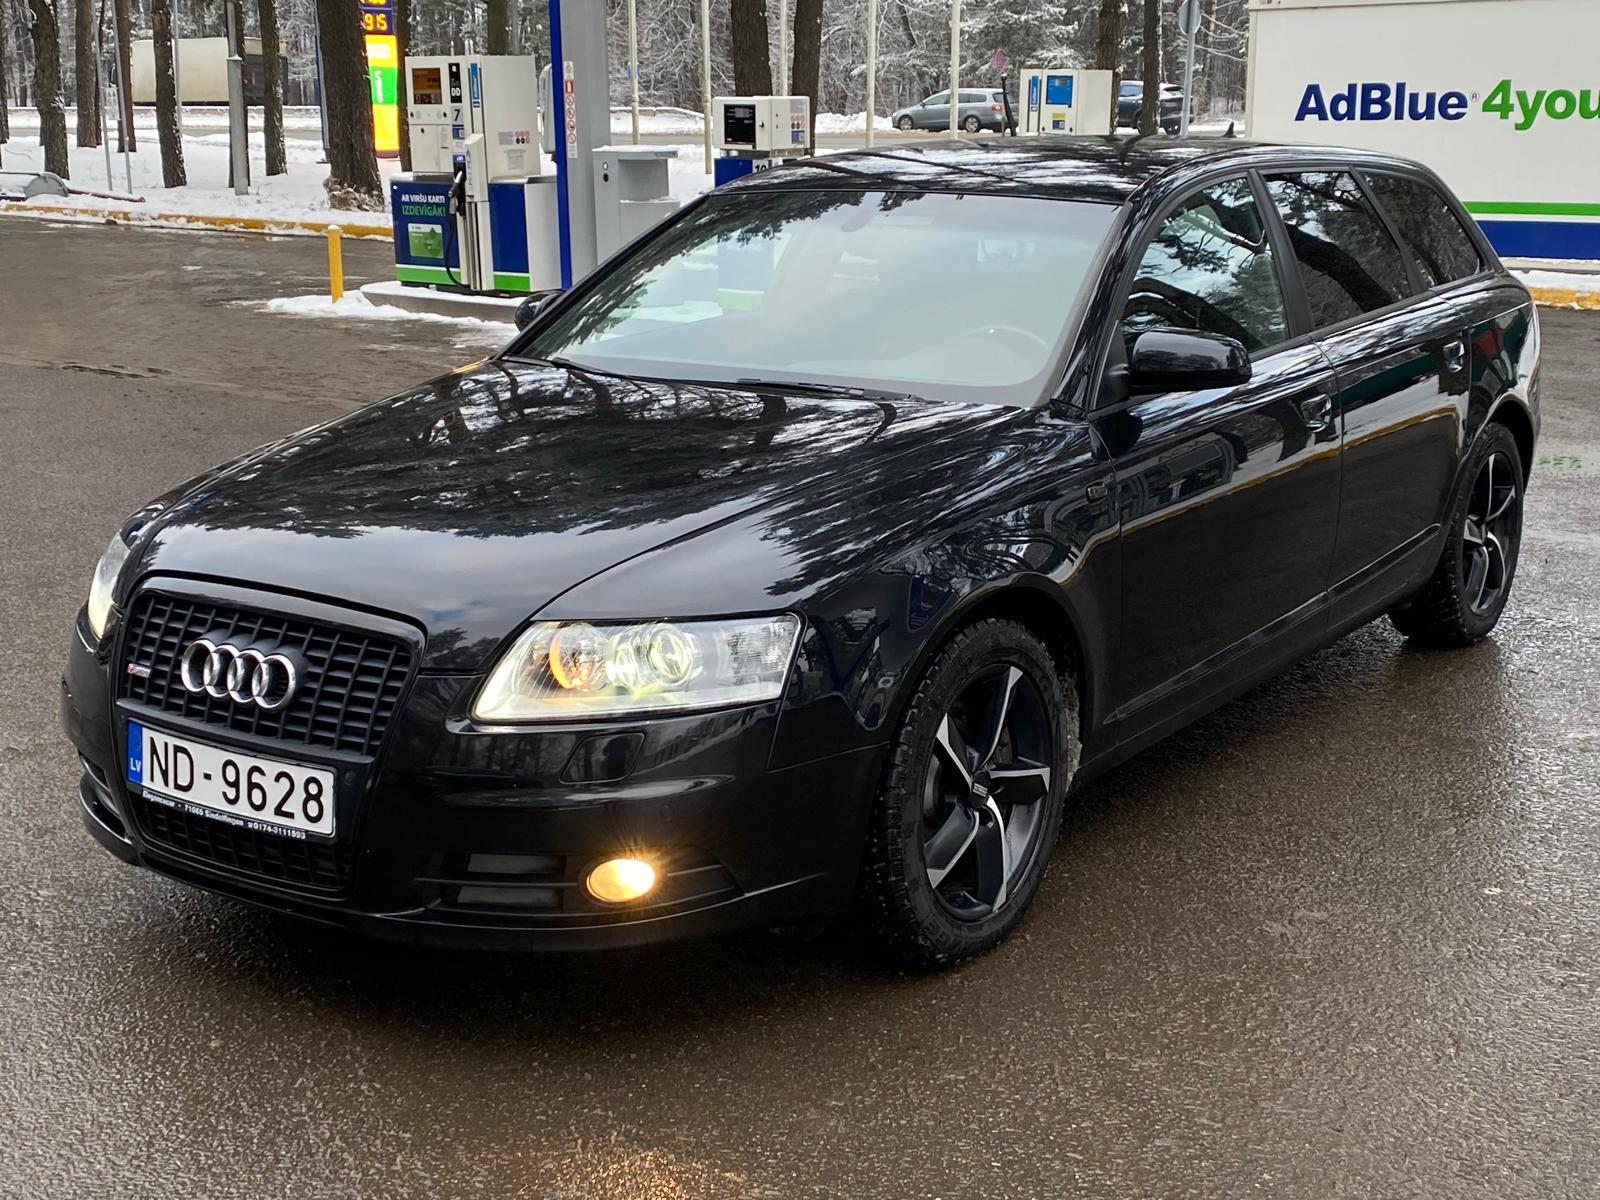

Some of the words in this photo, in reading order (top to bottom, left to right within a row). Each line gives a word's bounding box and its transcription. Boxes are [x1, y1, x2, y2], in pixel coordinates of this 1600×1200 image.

[1482, 79, 1600, 131] 4you
[454, 108, 461, 122] 7
[401, 194, 409, 202] AR
[131, 757, 142, 773] LV
[150, 736, 324, 824] ND-9628
